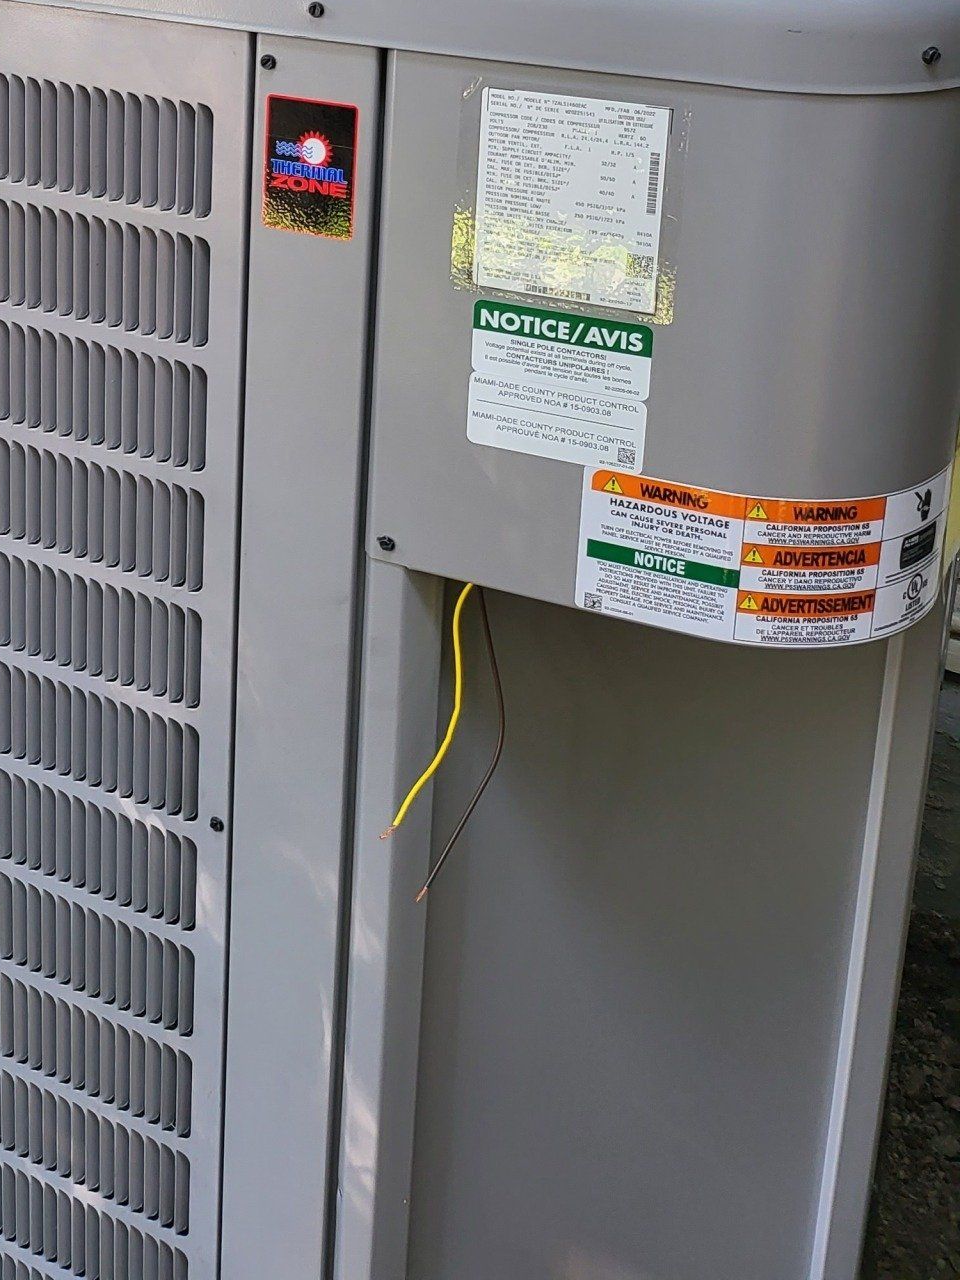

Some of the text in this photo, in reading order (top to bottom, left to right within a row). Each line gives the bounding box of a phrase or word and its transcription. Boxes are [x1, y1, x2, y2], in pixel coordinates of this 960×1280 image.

[271, 158, 349, 185] THERMAL
[271, 174, 347, 199] ZONE
[480, 307, 643, 353] NOTICE/AVIS
[485, 341, 505, 350] Voltage
[506, 345, 530, 354] potential
[531, 349, 546, 357] exists
[562, 354, 587, 364] terminals
[588, 359, 606, 368] during
[510, 339, 607, 361] SINGLE POLE CONTACTORS!
[499, 357, 520, 366] possible
[552, 366, 573, 375] tension
[584, 372, 601, 380] toutes
[506, 352, 557, 366] CONTACTEURS
[559, 361, 605, 374] UNIPOLAIRES
[524, 368, 546, 376] pendant
[474, 376, 639, 414] MIAMI-DADE COUNTY PRODUCT CONTROL
[498, 390, 542, 404] APPROVED
[544, 398, 561, 408] NOA
[570, 403, 611, 417] 15-0903.08
[472, 410, 637, 448] MIAMI-DADE COUNTY PRODUCT CONTROL
[542, 433, 559, 443] NOA
[568, 438, 609, 452] 15-0903.08
[639, 482, 709, 510] WARNING
[610, 497, 730, 530] HAZARDOUS VOLTAGE
[793, 506, 858, 522] WARNING
[611, 509, 727, 539] CAN CAUSE SEVERE PERSONAL
[631, 521, 660, 532] INJURY
[676, 530, 703, 540] DEATH.
[766, 524, 811, 533] CALIFORNIA
[813, 523, 860, 532] PROPOSITION
[620, 534, 639, 543] SERVICE
[626, 529, 652, 539] ELECTRICAL
[654, 535, 672, 543] POWER
[673, 539, 691, 548] BEFORE
[644, 545, 663, 553] SERVICE
[772, 550, 866, 567] ADVERTENCIA
[634, 551, 686, 575] NOTICE
[762, 569, 807, 577] CALIFORNIA
[809, 569, 856, 577] PROPOSITION
[814, 576, 862, 584] REPRODUCTIVO
[760, 594, 874, 613] ADVERTISSEMENT
[756, 615, 800, 623] CALIFORNIA
[803, 616, 848, 624] PROPOSITION
[806, 628, 855, 636] REPRODUCTEUR
